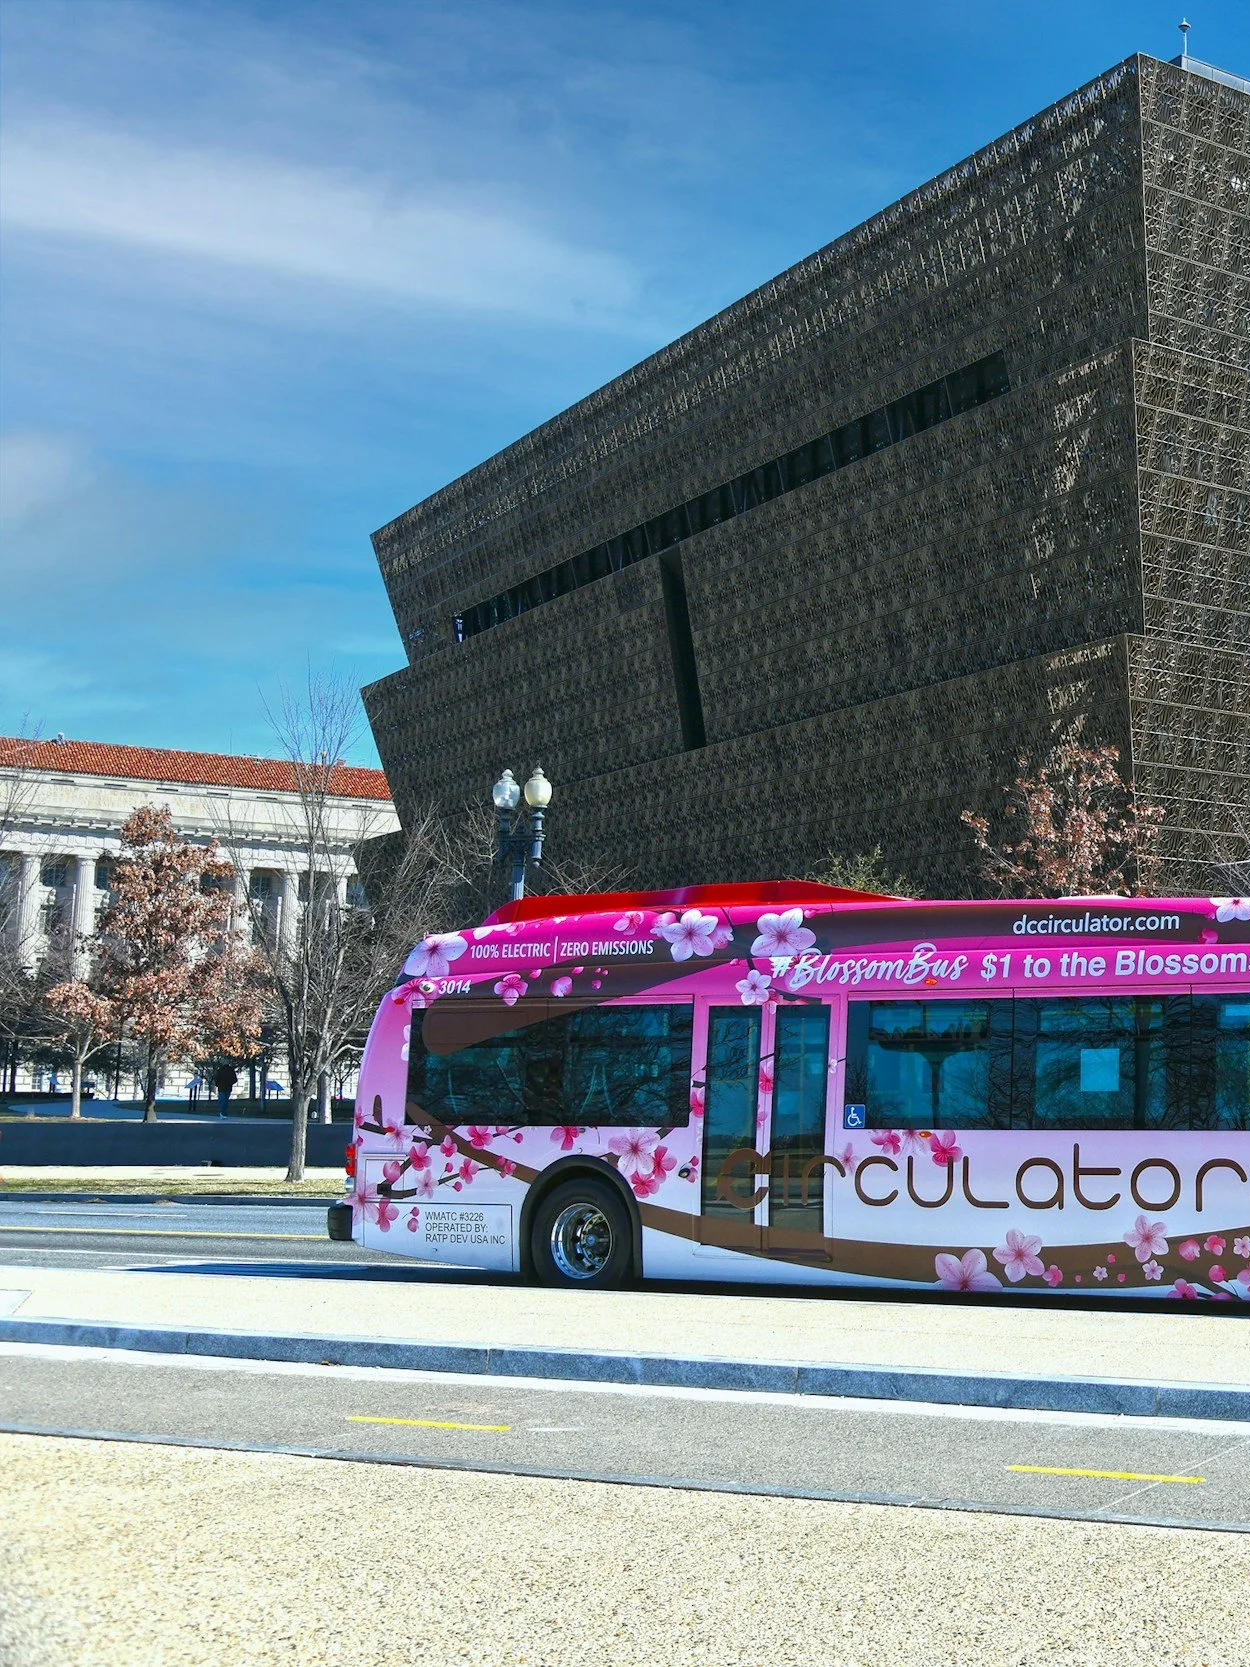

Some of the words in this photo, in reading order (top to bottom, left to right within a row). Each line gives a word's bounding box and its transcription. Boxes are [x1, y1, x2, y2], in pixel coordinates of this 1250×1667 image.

[1012, 912, 1180, 935] dccirculator.com
[470, 944, 499, 959] 100%
[502, 943, 551, 958] ELECTRIC
[560, 941, 589, 957] ZERO
[591, 939, 654, 956] EMISSIONS
[769, 942, 969, 991] #BlossomBus
[980, 952, 1011, 981] $1
[1023, 954, 1051, 978] to
[1060, 952, 1106, 977] the
[438, 979, 471, 995] 3014
[425, 1211, 457, 1221] WMATC
[459, 1212, 484, 1222] #3226
[425, 1222, 472, 1232] OPERATED
[474, 1223, 488, 1233] BY:
[425, 1233, 448, 1243] RATP
[450, 1234, 469, 1243] DEV
[470, 1235, 489, 1244] USA
[490, 1235, 506, 1245] INC
